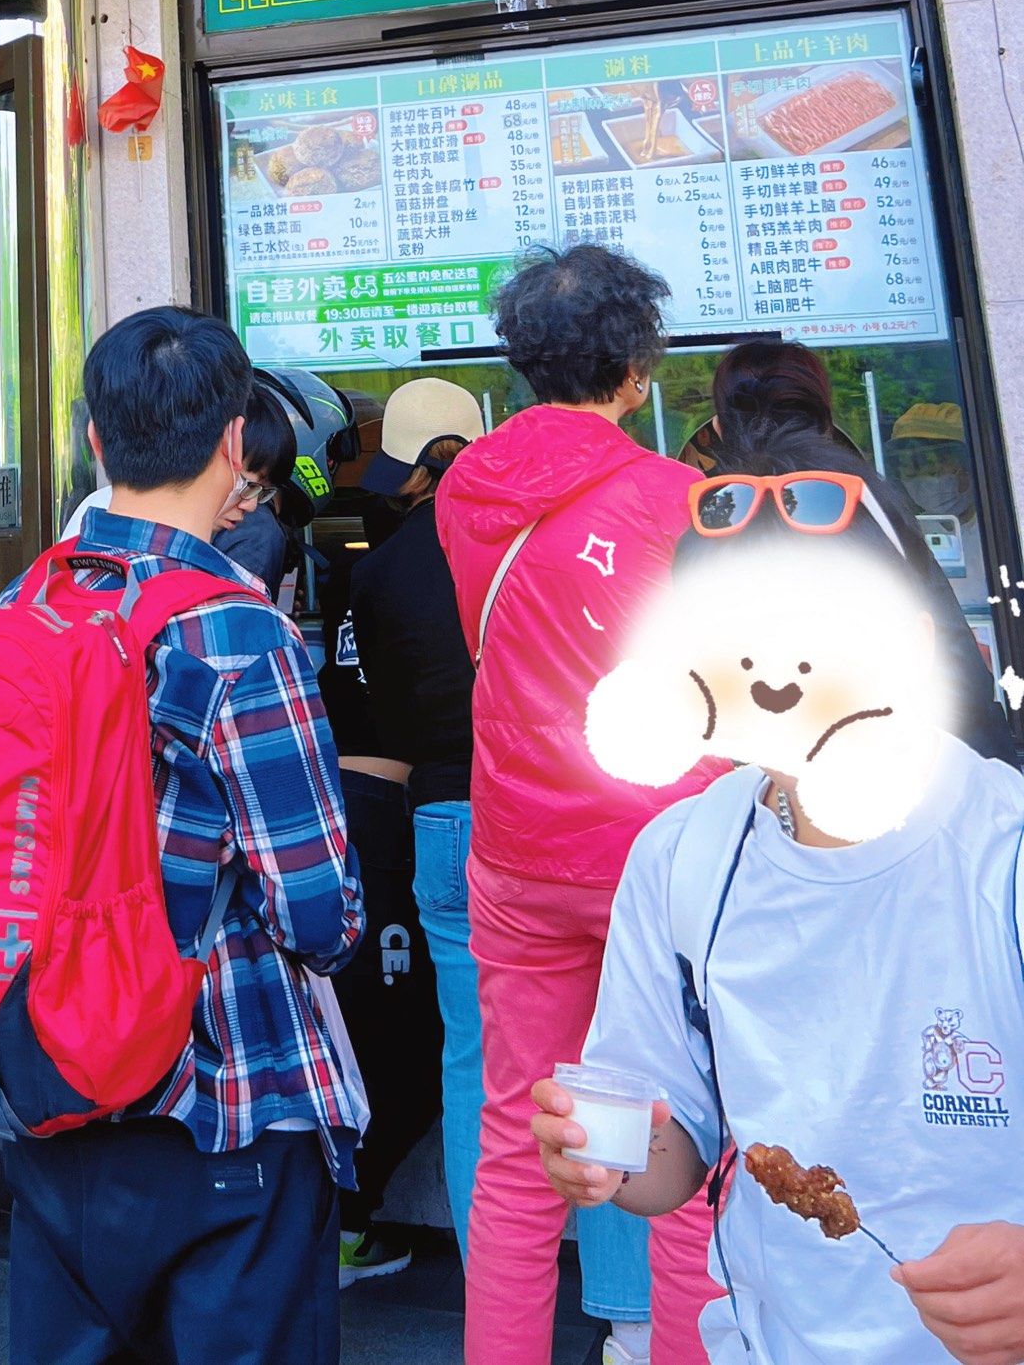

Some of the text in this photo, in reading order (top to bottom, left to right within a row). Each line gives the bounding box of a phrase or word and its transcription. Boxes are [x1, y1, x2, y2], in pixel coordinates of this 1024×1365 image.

[754, 32, 869, 62] 上品牛羊肉
[604, 54, 652, 78] 涮料
[258, 87, 339, 112] 京味主食
[392, 149, 460, 167] 老北京酸菜
[393, 167, 434, 182] 牛肉丸
[740, 162, 816, 181] 手切鲜羊肉
[562, 176, 634, 195] 秘制麻酱料
[742, 181, 818, 199] 手切鲜羊腱
[237, 202, 287, 218] 一品烧饼
[564, 192, 635, 211] 自制香辣酱
[744, 199, 836, 218] 手切鲜羊上脑
[396, 208, 478, 226] 牛街绿豆粉丝
[564, 209, 637, 226] 香油蒜泥料
[238, 220, 302, 236] 绿色蔬菜面
[745, 219, 823, 237] 高钙羔羊肉
[398, 242, 424, 256] 宽粉
[747, 239, 809, 257] 精品羊肉
[750, 257, 822, 275] A眼肉肥牛
[247, 275, 347, 304] 自营外卖
[753, 277, 814, 295] 上脑肥牛
[754, 297, 816, 315] 相间肥牛
[318, 321, 475, 353] 外卖取餐口
[9, 775, 40, 896] SWISSWIN
[957, 1041, 1005, 1094] C
[923, 1093, 1009, 1114] CORNELL
[924, 1111, 1010, 1127] UNIVERSITY
